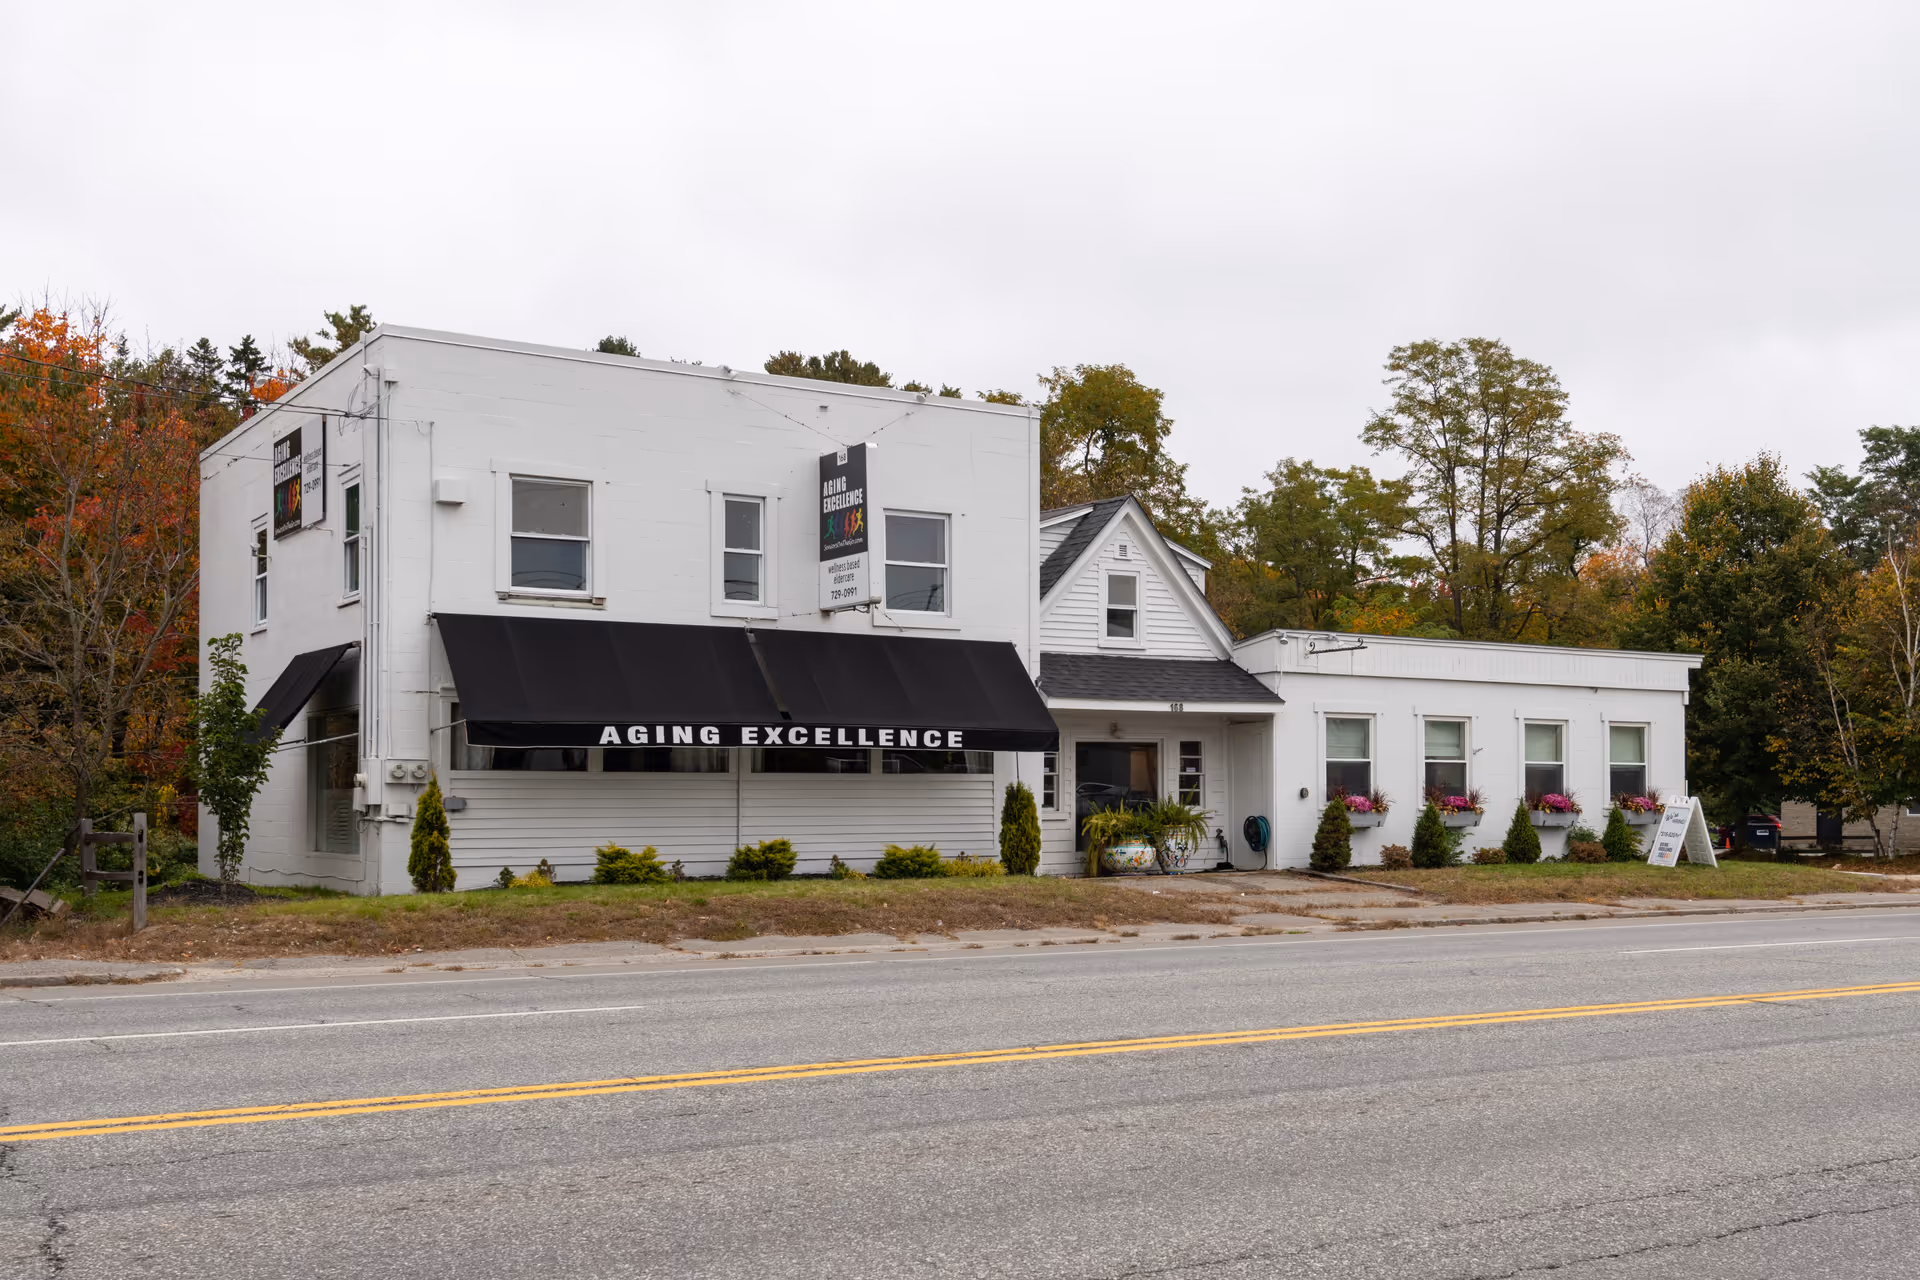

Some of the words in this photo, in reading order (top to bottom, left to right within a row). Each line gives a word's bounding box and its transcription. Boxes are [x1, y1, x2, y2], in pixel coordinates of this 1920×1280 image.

[823, 476, 847, 497] AGING
[823, 488, 863, 513] EXCELLENCE
[828, 562, 847, 574] wellness
[846, 556, 861, 571] based
[833, 572, 855, 584] eldercare
[831, 586, 857, 601] 729-0991
[1170, 703, 1184, 712] 168
[599, 725, 721, 745] AGING
[741, 726, 963, 748] EXCELLENCE
